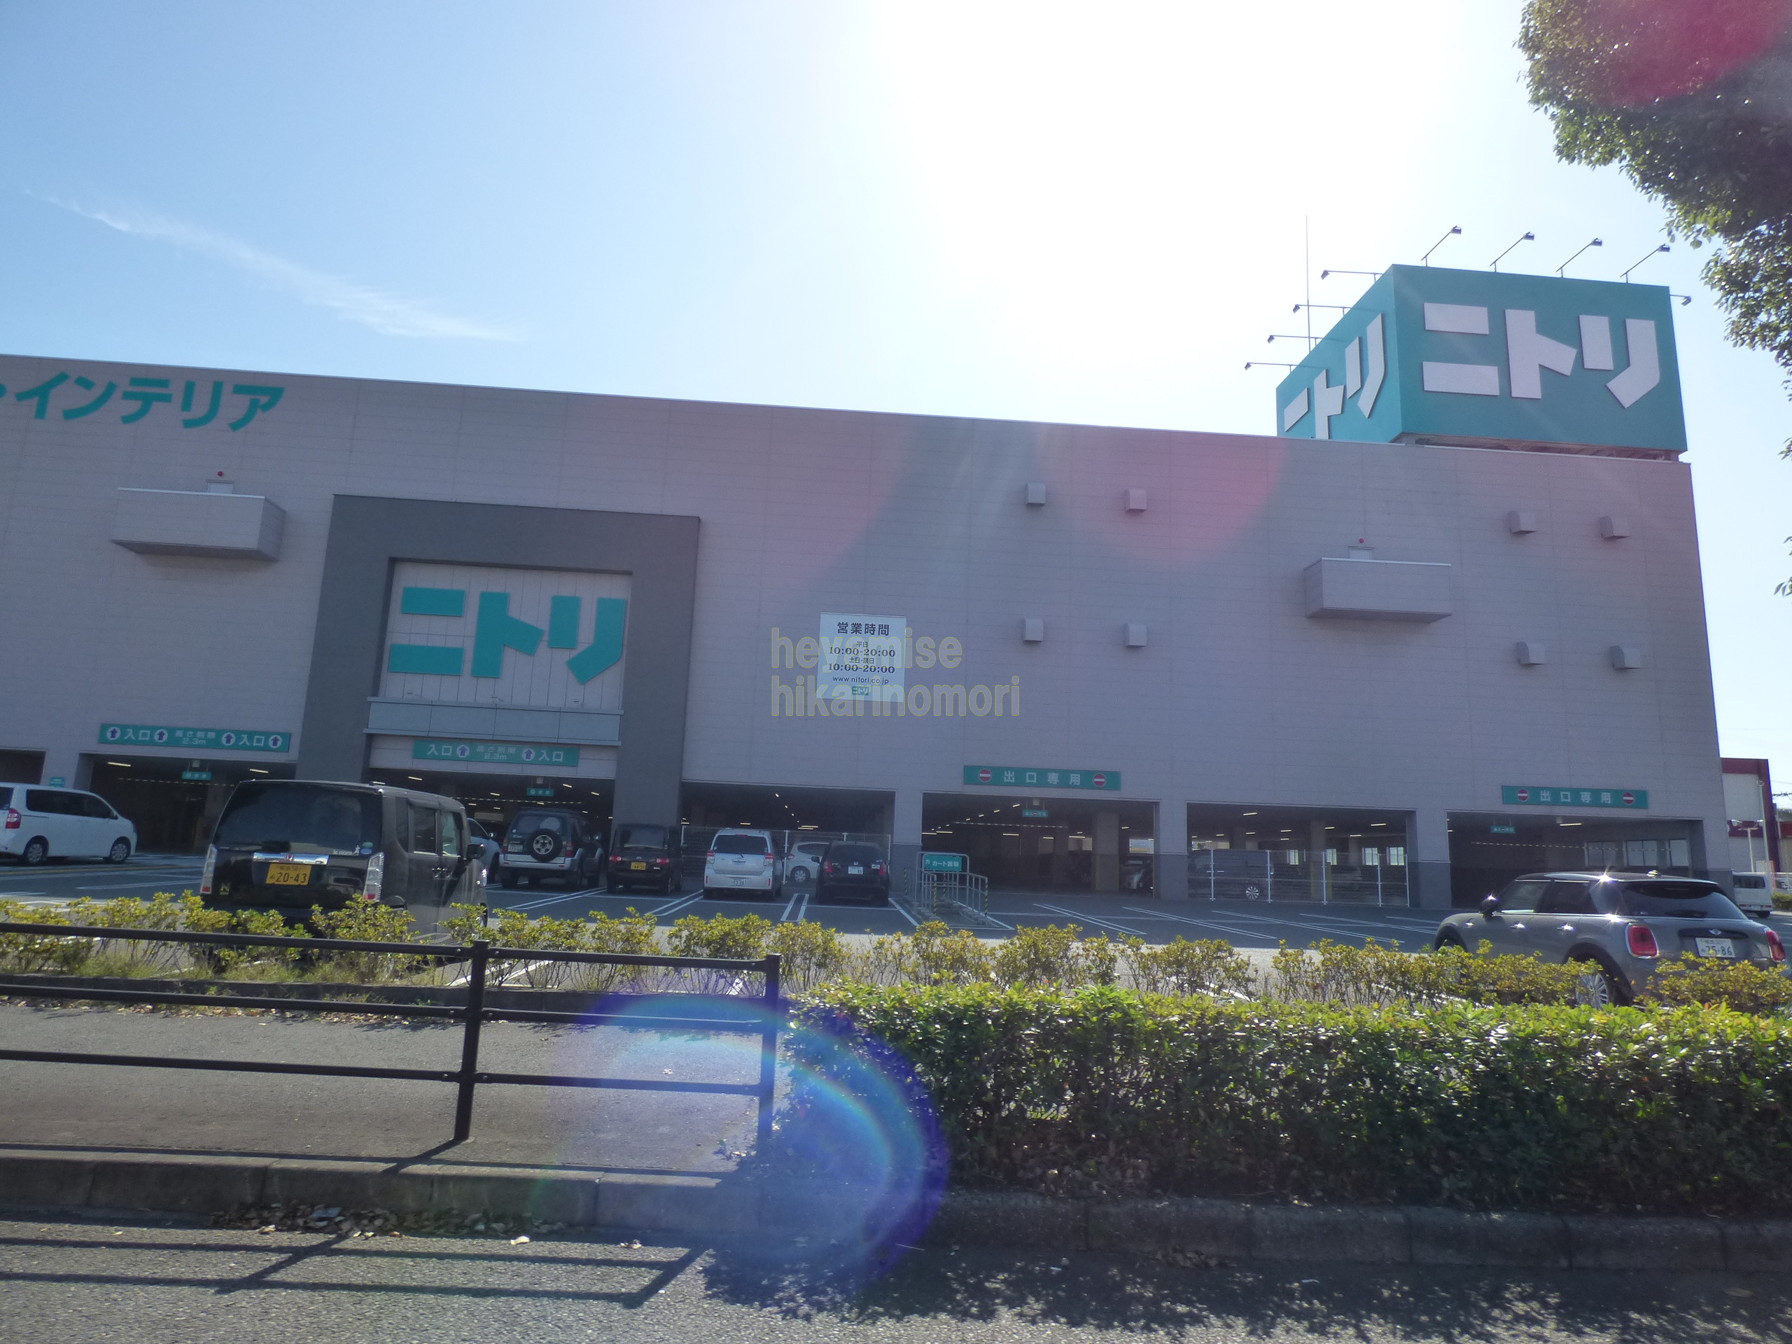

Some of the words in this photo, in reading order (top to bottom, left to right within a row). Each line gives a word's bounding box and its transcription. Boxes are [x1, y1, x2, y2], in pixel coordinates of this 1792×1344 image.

[1422, 302, 1660, 409] ニトリ
[15, 371, 285, 432] インテリア
[388, 586, 626, 685] ニトリ
[837, 622, 890, 637] 営業時間
[829, 646, 896, 658] 10:00-20:00
[828, 663, 896, 674] 10:00-20:00
[124, 729, 150, 741] 入口
[239, 734, 265, 747] 入口
[426, 743, 453, 757] 入口
[538, 750, 564, 763] 入口
[1003, 770, 1081, 786] 出口専用
[1540, 789, 1611, 804] 出口専用
[275, 871, 308, 884] 20-43
